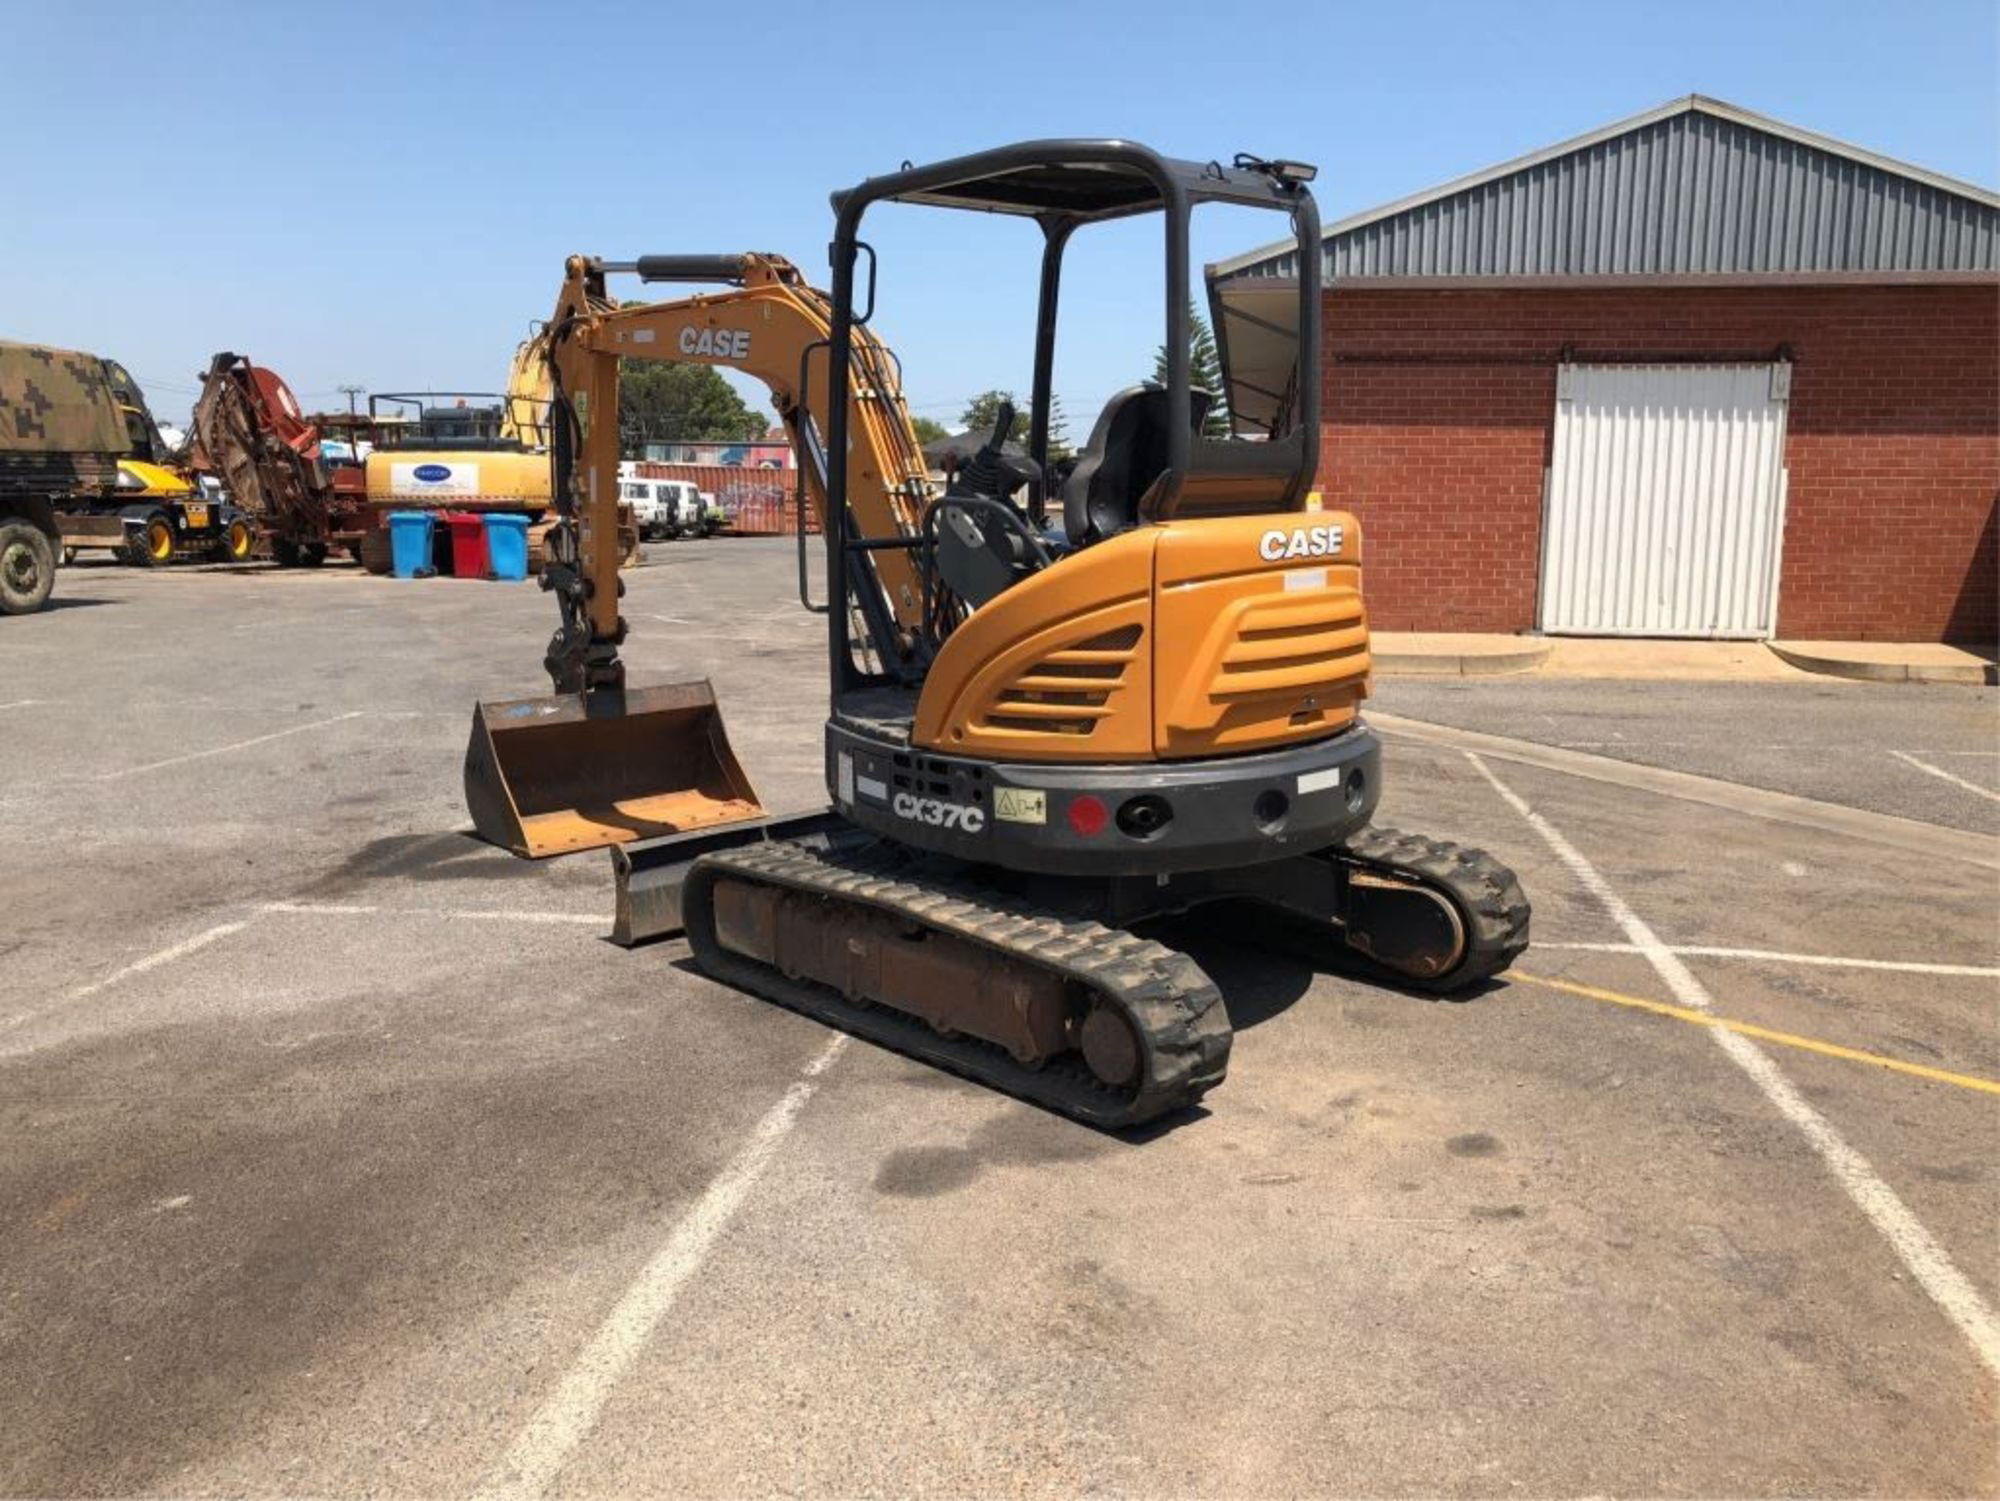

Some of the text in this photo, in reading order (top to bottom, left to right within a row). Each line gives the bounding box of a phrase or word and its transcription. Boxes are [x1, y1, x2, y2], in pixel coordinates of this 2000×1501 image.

[680, 327, 751, 358] CASE
[1260, 525, 1343, 561] CASE
[893, 793, 985, 833] CX37C
